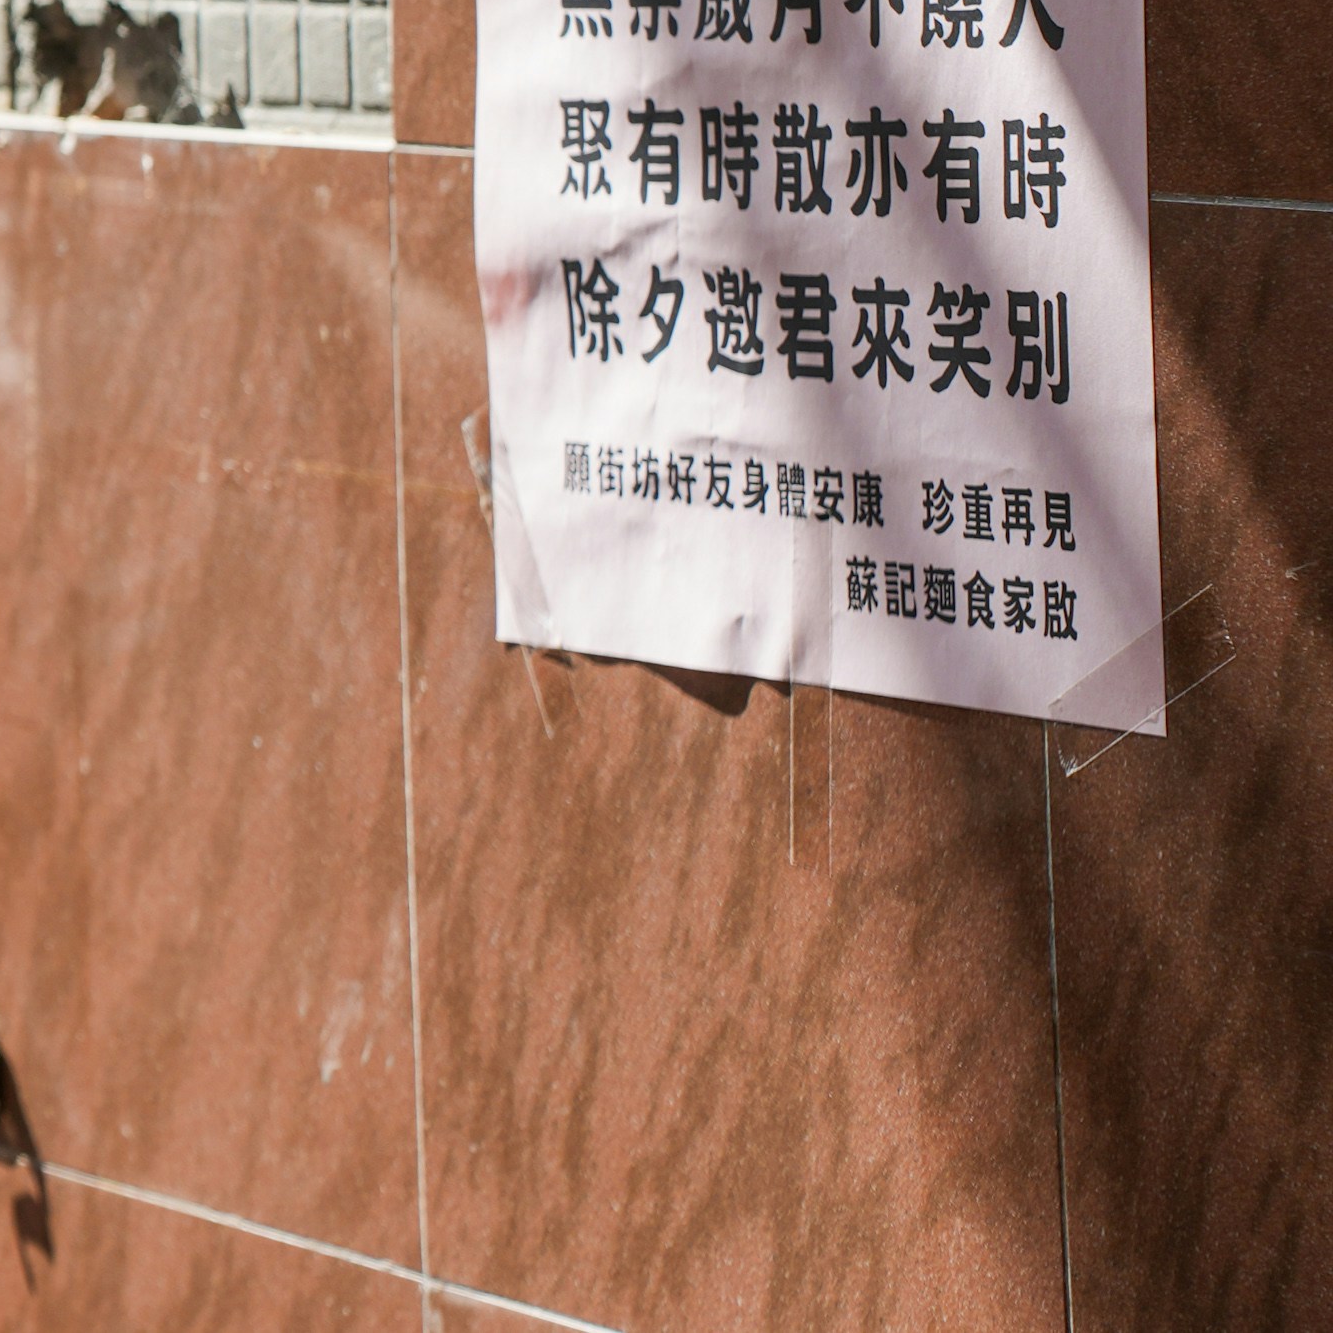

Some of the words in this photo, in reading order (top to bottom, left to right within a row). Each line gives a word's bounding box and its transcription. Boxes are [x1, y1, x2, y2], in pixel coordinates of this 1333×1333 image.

[559, 97, 1068, 229] 聚有時散亦有時
[561, 258, 1071, 405] 除夕邀君來笑別
[563, 440, 884, 529] 願街坊好友身體安康
[921, 477, 1077, 552] 珍重再見
[845, 554, 1079, 642] 蘇記麵食家啟
